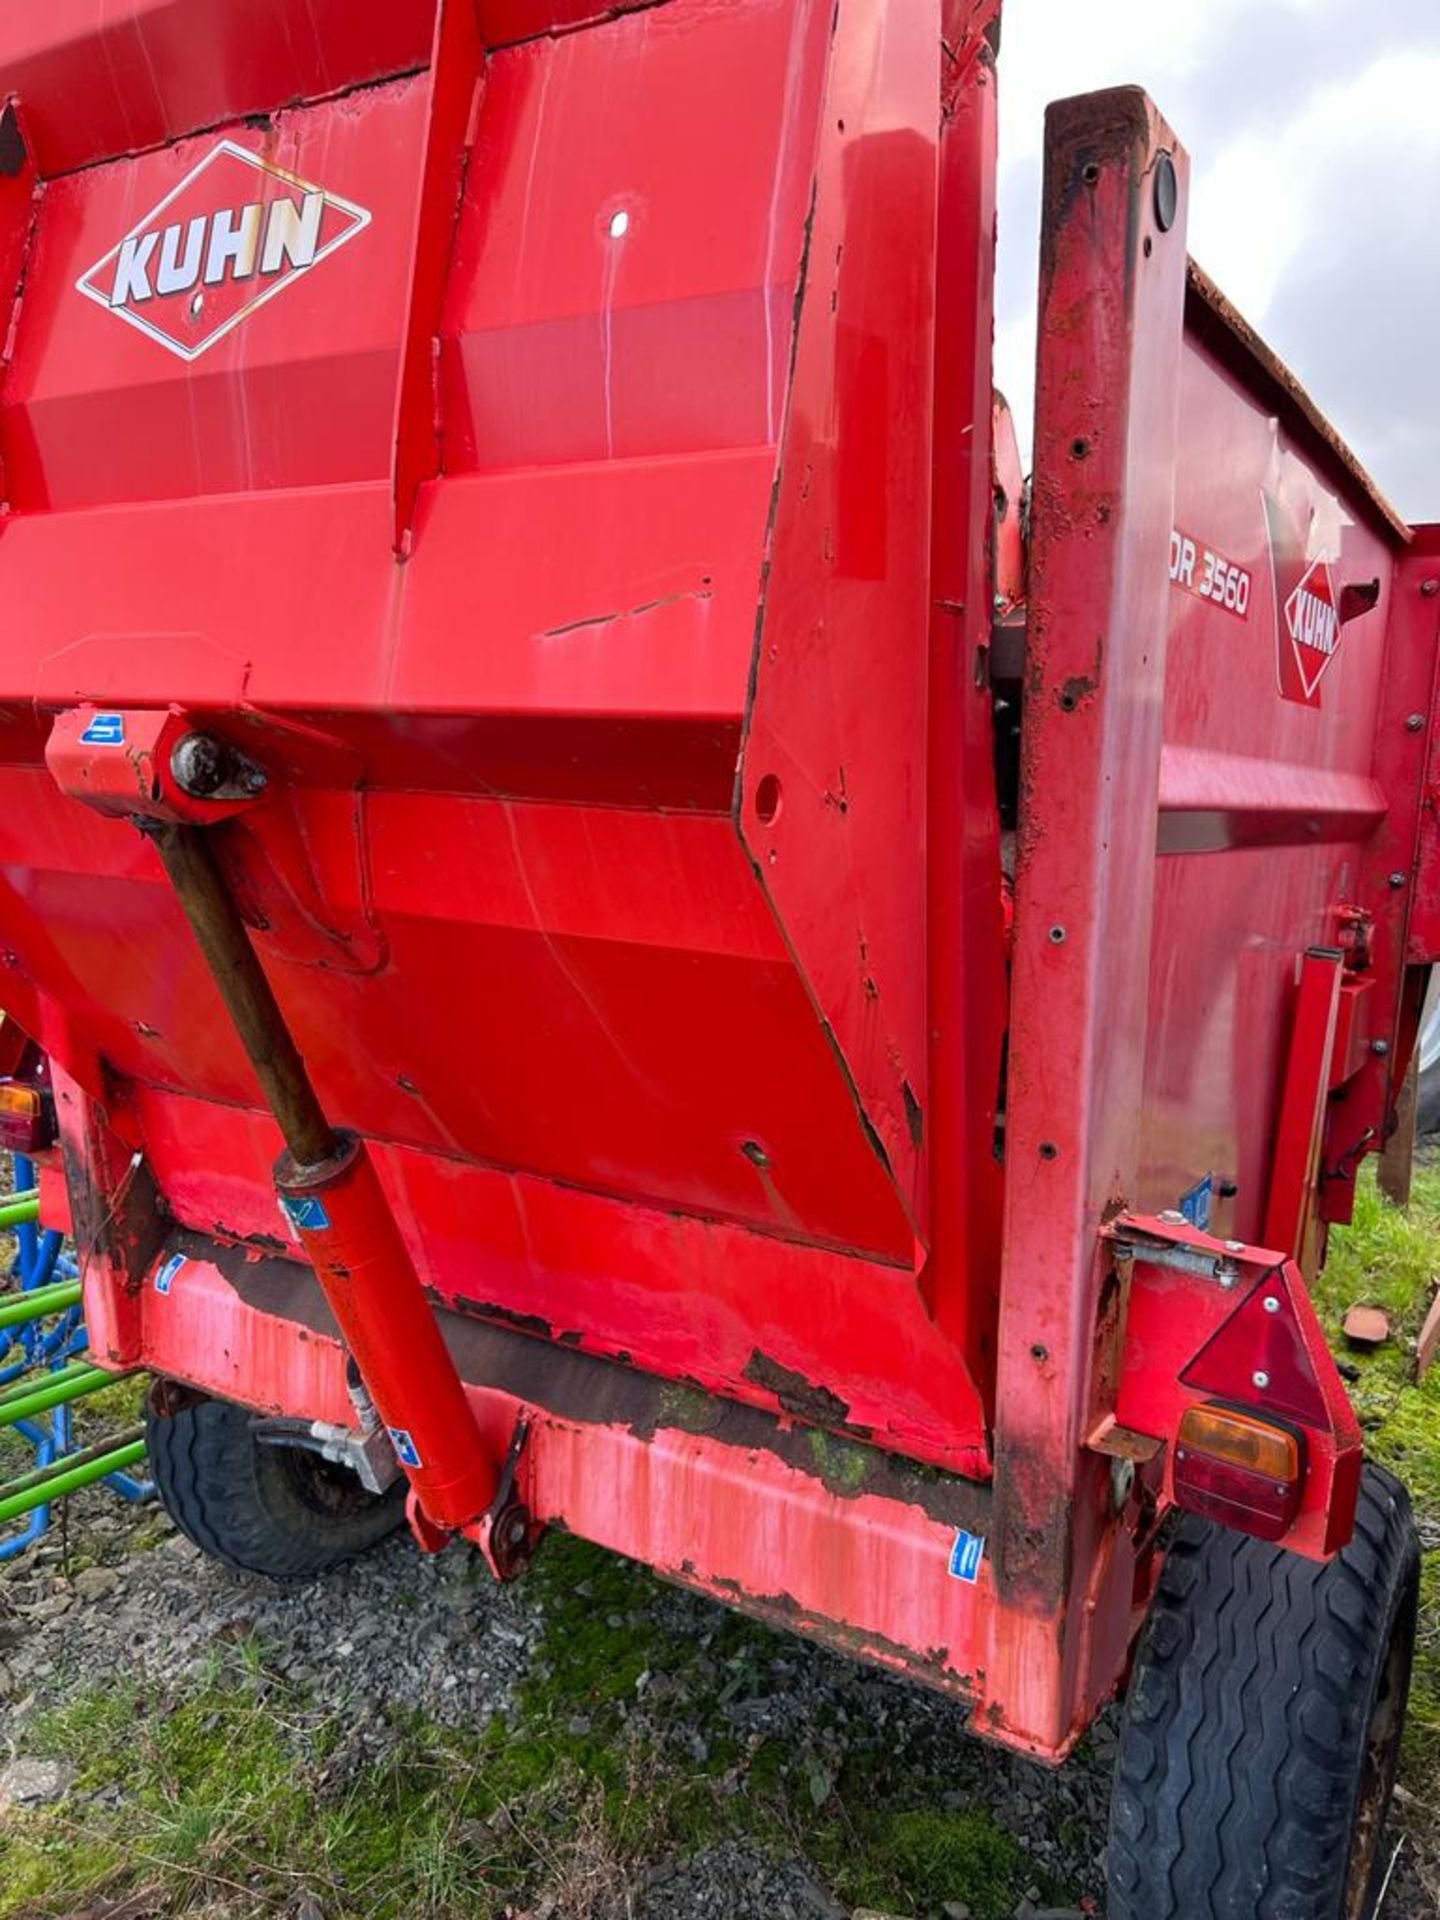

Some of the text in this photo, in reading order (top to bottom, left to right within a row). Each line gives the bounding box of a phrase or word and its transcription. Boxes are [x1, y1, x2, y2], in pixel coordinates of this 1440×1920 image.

[109, 190, 324, 307] KUHN
[1199, 550, 1250, 615] 3560
[1291, 588, 1337, 655] KUHN
